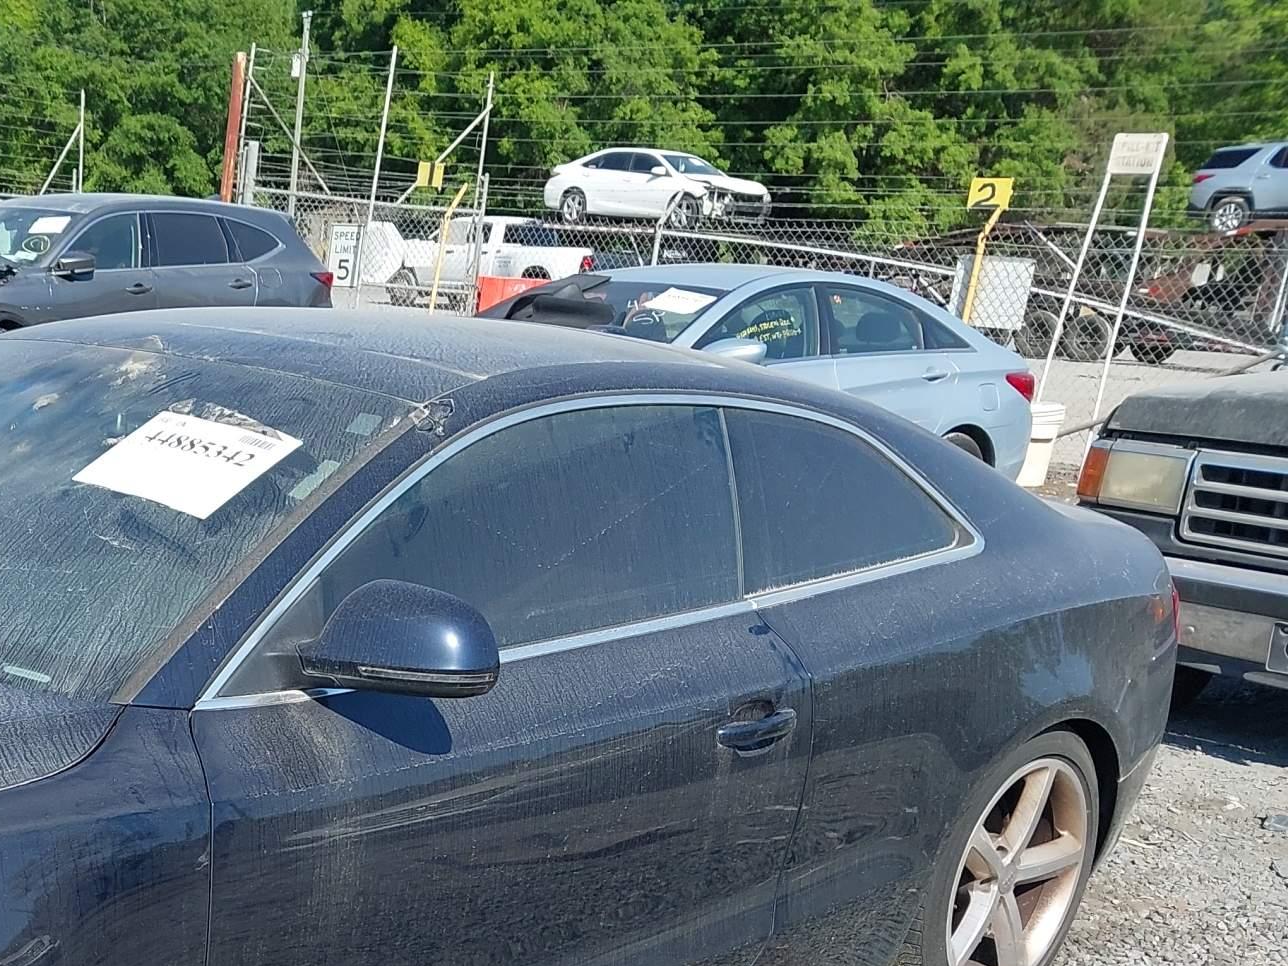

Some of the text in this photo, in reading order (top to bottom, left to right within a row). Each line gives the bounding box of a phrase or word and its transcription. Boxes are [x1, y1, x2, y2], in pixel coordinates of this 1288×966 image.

[970, 183, 1001, 207] 2
[334, 231, 361, 241] SPEED
[334, 244, 358, 254] LIMIT
[336, 258, 350, 281] 5
[144, 430, 256, 467] 44885342
